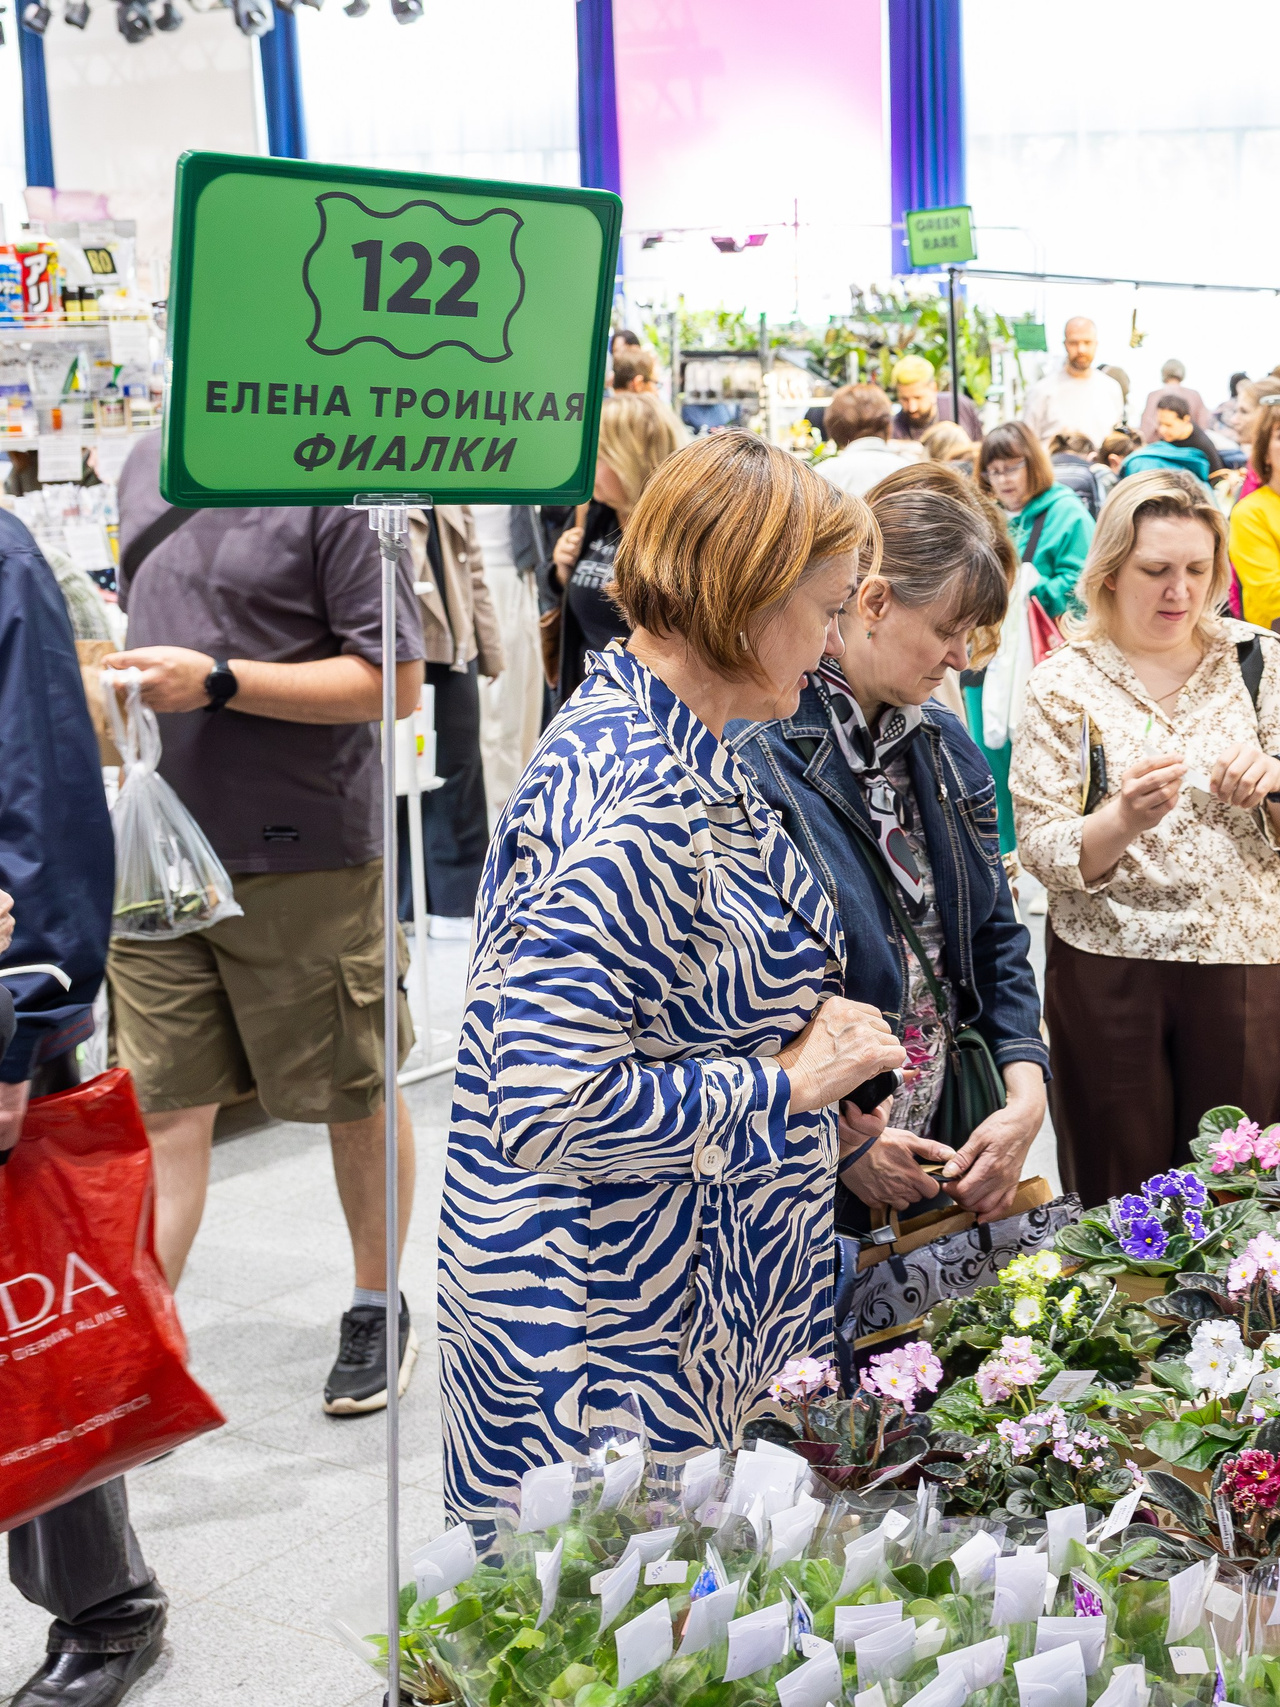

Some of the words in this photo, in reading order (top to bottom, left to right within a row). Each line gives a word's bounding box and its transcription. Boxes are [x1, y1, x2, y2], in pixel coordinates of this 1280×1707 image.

[916, 216, 960, 232] GREEN
[922, 234, 959, 250] RARE
[351, 239, 481, 318] 122
[205, 380, 352, 417] ЕЛЕНА
[369, 386, 586, 427] ТРОИЦКАЯ
[293, 433, 519, 473] ФИАЛКИ
